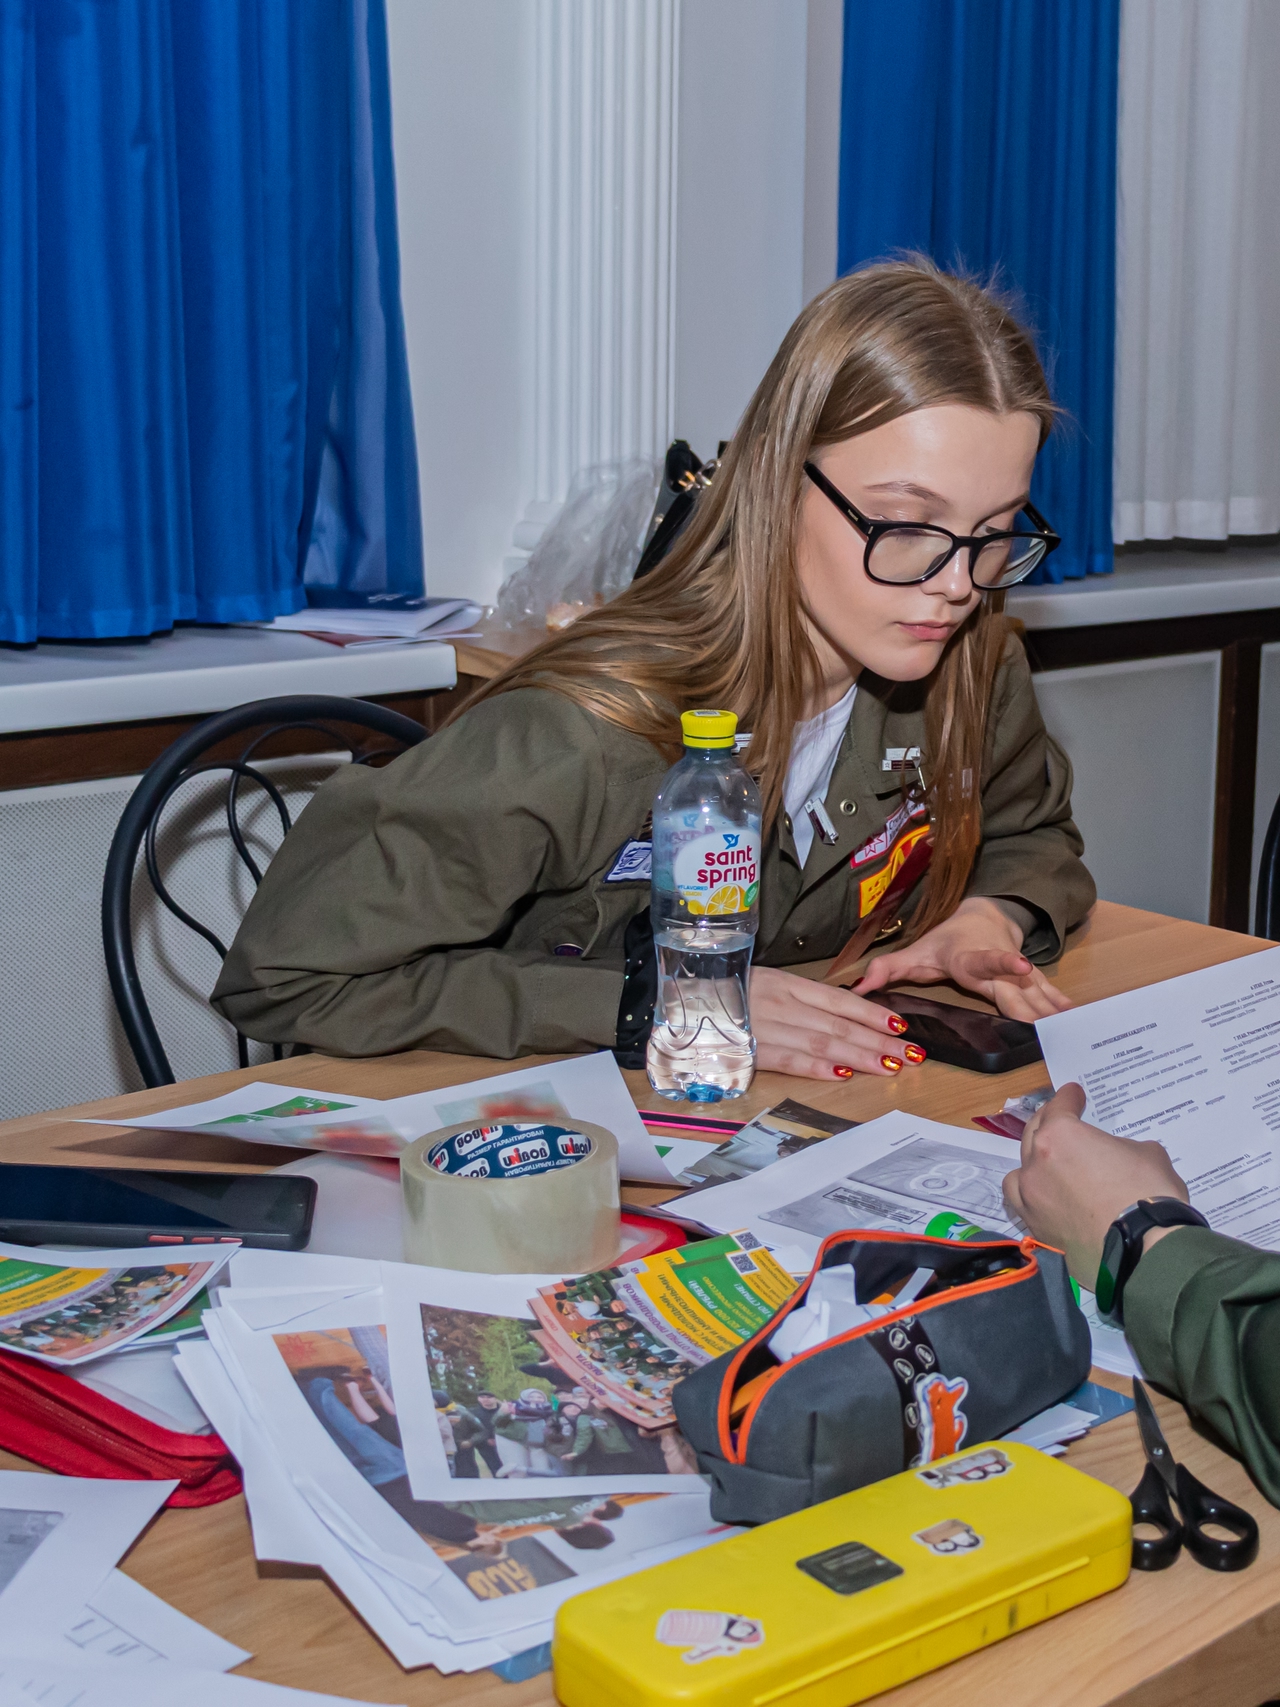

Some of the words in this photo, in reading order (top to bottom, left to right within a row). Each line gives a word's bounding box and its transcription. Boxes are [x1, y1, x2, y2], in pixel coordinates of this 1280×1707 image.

[705, 846, 752, 866] saint
[697, 863, 756, 888] spring
[1115, 1125, 1128, 1133] ЭТАП.
[467, 1145, 491, 1160] РАЗМЕР
[493, 1129, 544, 1148] ГАРАНТИРОВАН
[504, 1160, 554, 1176] ГАРАНТИРОВАН
[656, 1272, 714, 1332] АМБИЦИОЗНЫМИ!
[687, 1277, 718, 1310] РУБЛЕЙ!
[732, 1281, 761, 1307] СТРАНЕ!
[621, 1281, 670, 1334] ПРОВОДНИКОВ
[658, 1291, 700, 1333] МОЛОДЫМИ,
[665, 1331, 691, 1352] ОТРЯД
[575, 1353, 603, 1377] РАБОТА
